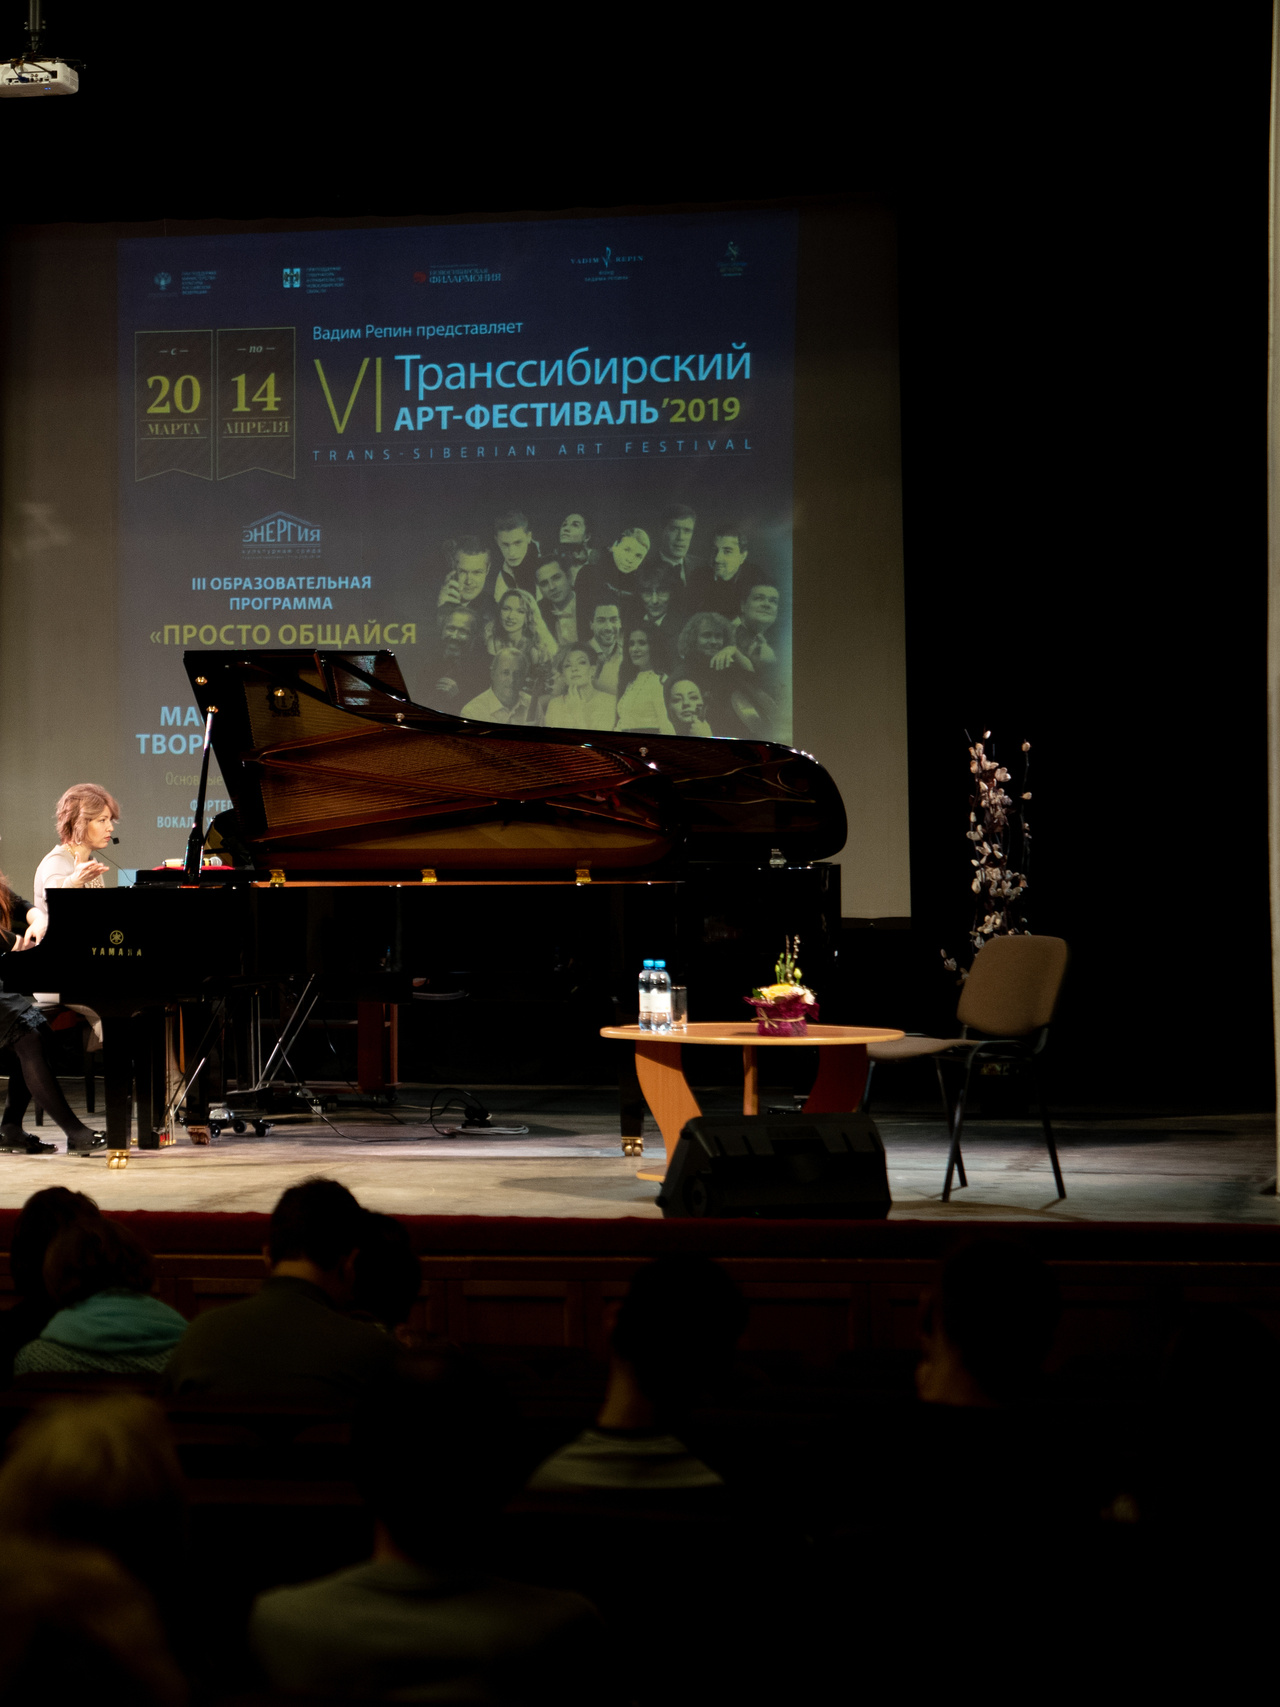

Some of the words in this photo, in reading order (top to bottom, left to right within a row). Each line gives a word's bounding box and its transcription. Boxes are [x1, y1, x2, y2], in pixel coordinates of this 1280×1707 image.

[313, 326, 361, 341] Вадим
[366, 324, 412, 338] Репин
[416, 321, 523, 340] представляет
[394, 342, 751, 401] Транссибирский
[146, 374, 201, 414] 20
[231, 372, 281, 412] 14
[314, 357, 382, 434] VI
[147, 423, 200, 435] МАРТА
[223, 421, 289, 434] АПРЕЛЯ
[313, 445, 536, 461] TRANS-SIBERIAN
[558, 443, 603, 455] ART
[625, 439, 752, 453] FESTIVAL
[242, 518, 320, 542] ЭНЕРГИЯ
[191, 577, 206, 590] III
[210, 576, 372, 590] ОБРАЗОВАТЕЛЬНАЯ
[229, 597, 333, 611] ПРОГРАММА
[150, 624, 270, 645] «ПРОСТО
[278, 619, 416, 649] ОБЩАЙСЯ
[160, 706, 203, 727] МА
[135, 733, 204, 755] ТВОР
[165, 771, 224, 786] Основые
[91, 947, 142, 956] YAMAHA
